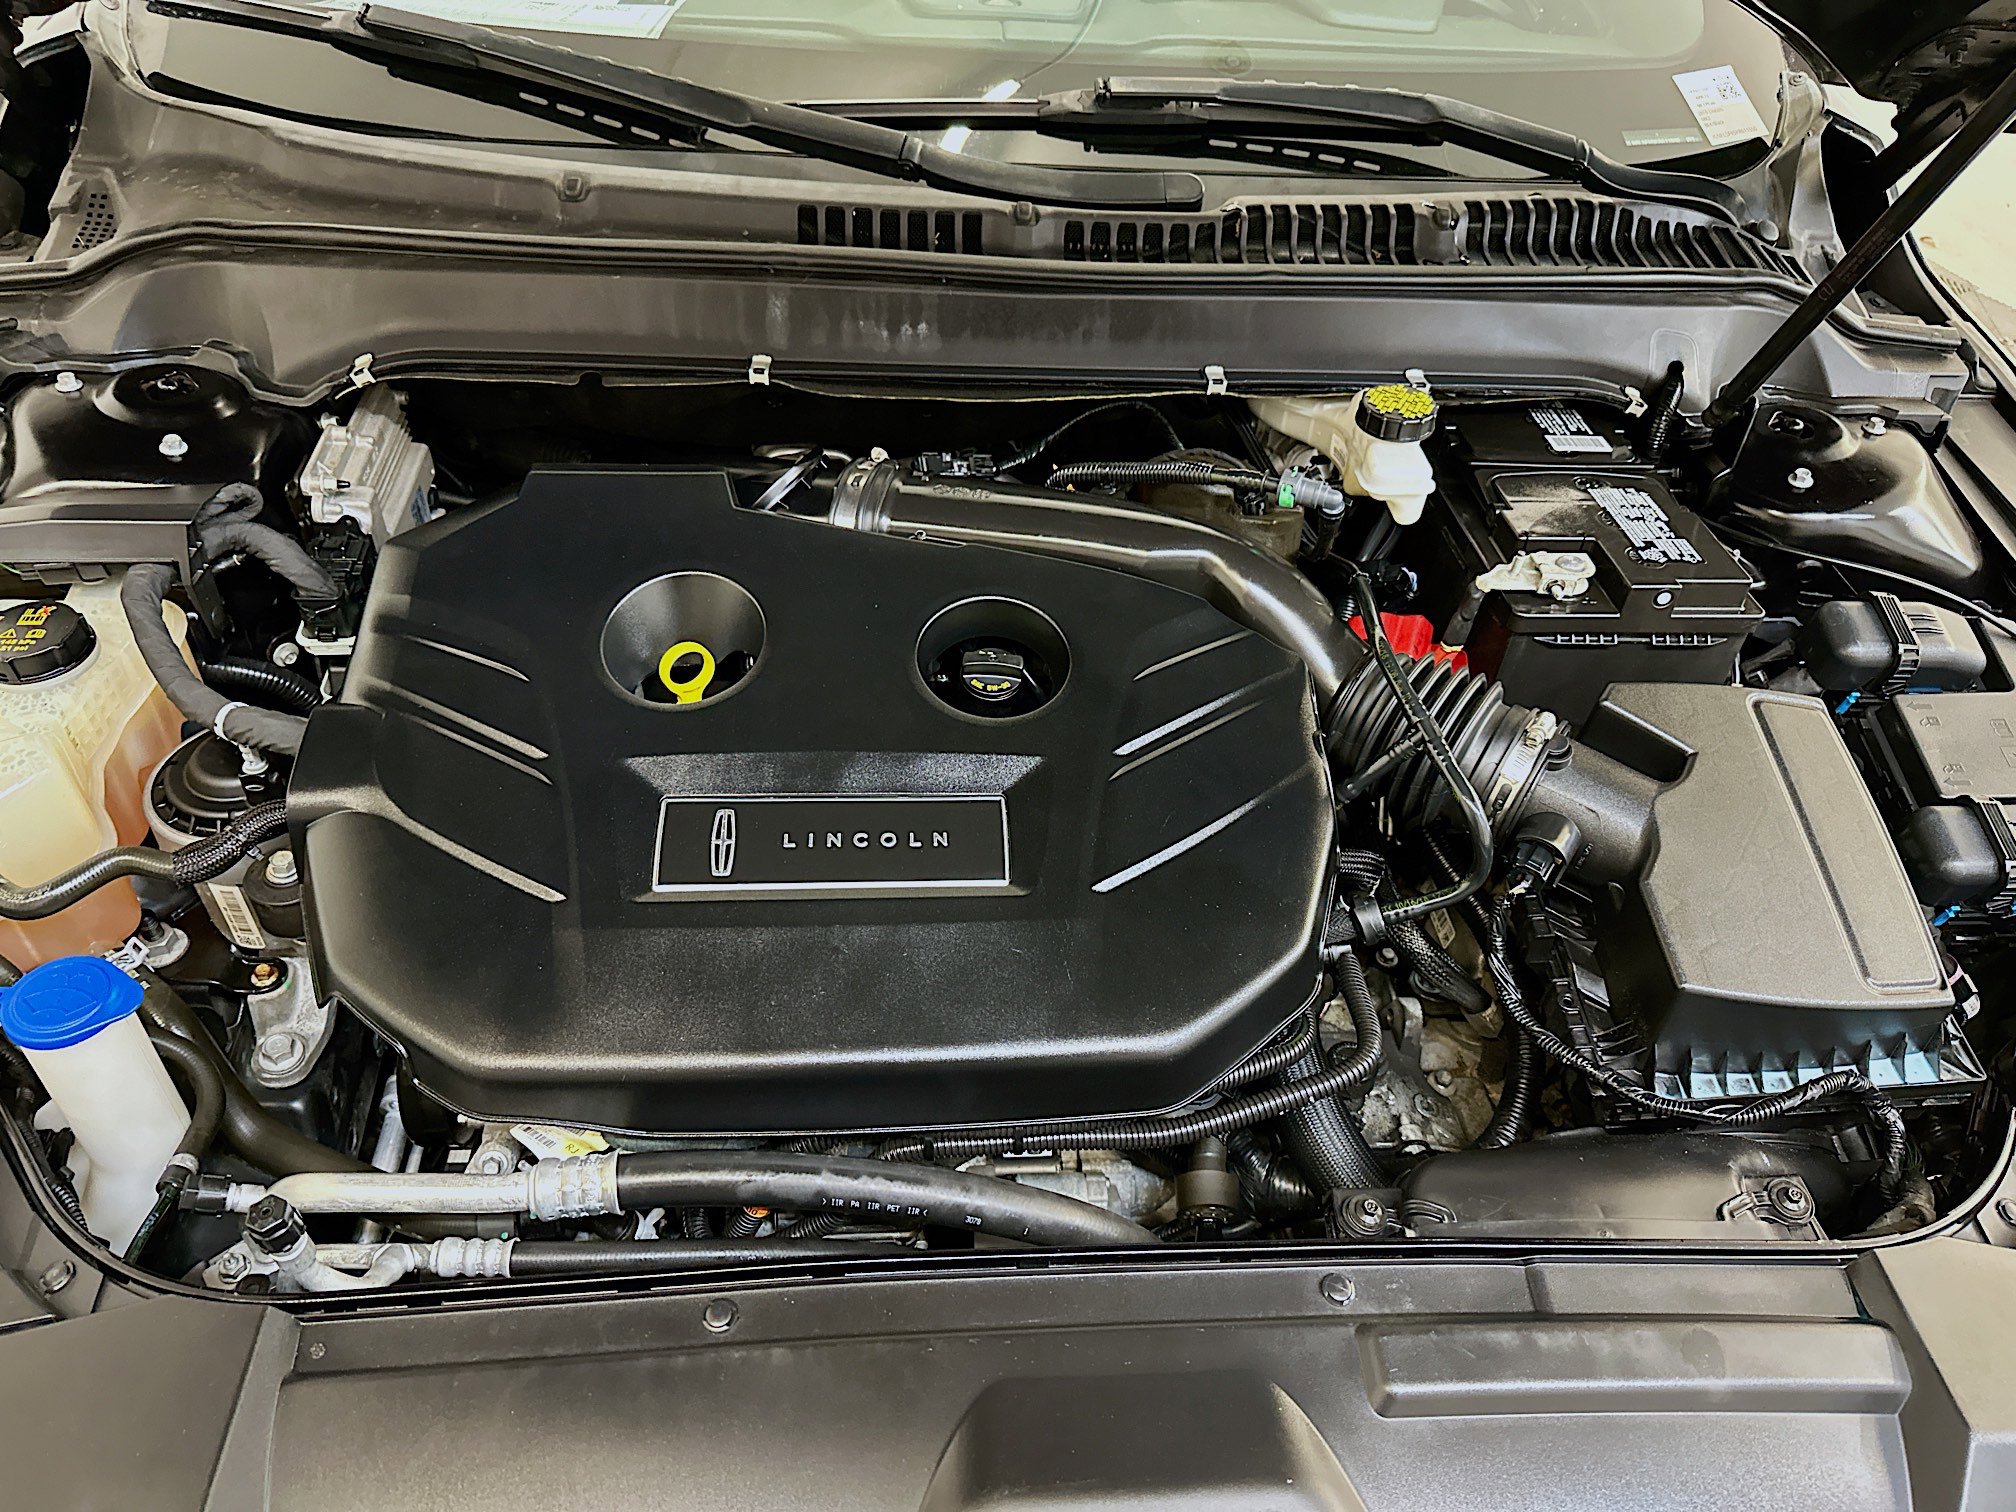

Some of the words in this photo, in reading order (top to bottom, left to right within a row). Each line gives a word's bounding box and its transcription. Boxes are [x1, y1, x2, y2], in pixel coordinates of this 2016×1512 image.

[782, 832, 949, 848] LINCOLN
[850, 1200, 860, 1208] PA
[886, 1204, 900, 1213] PET
